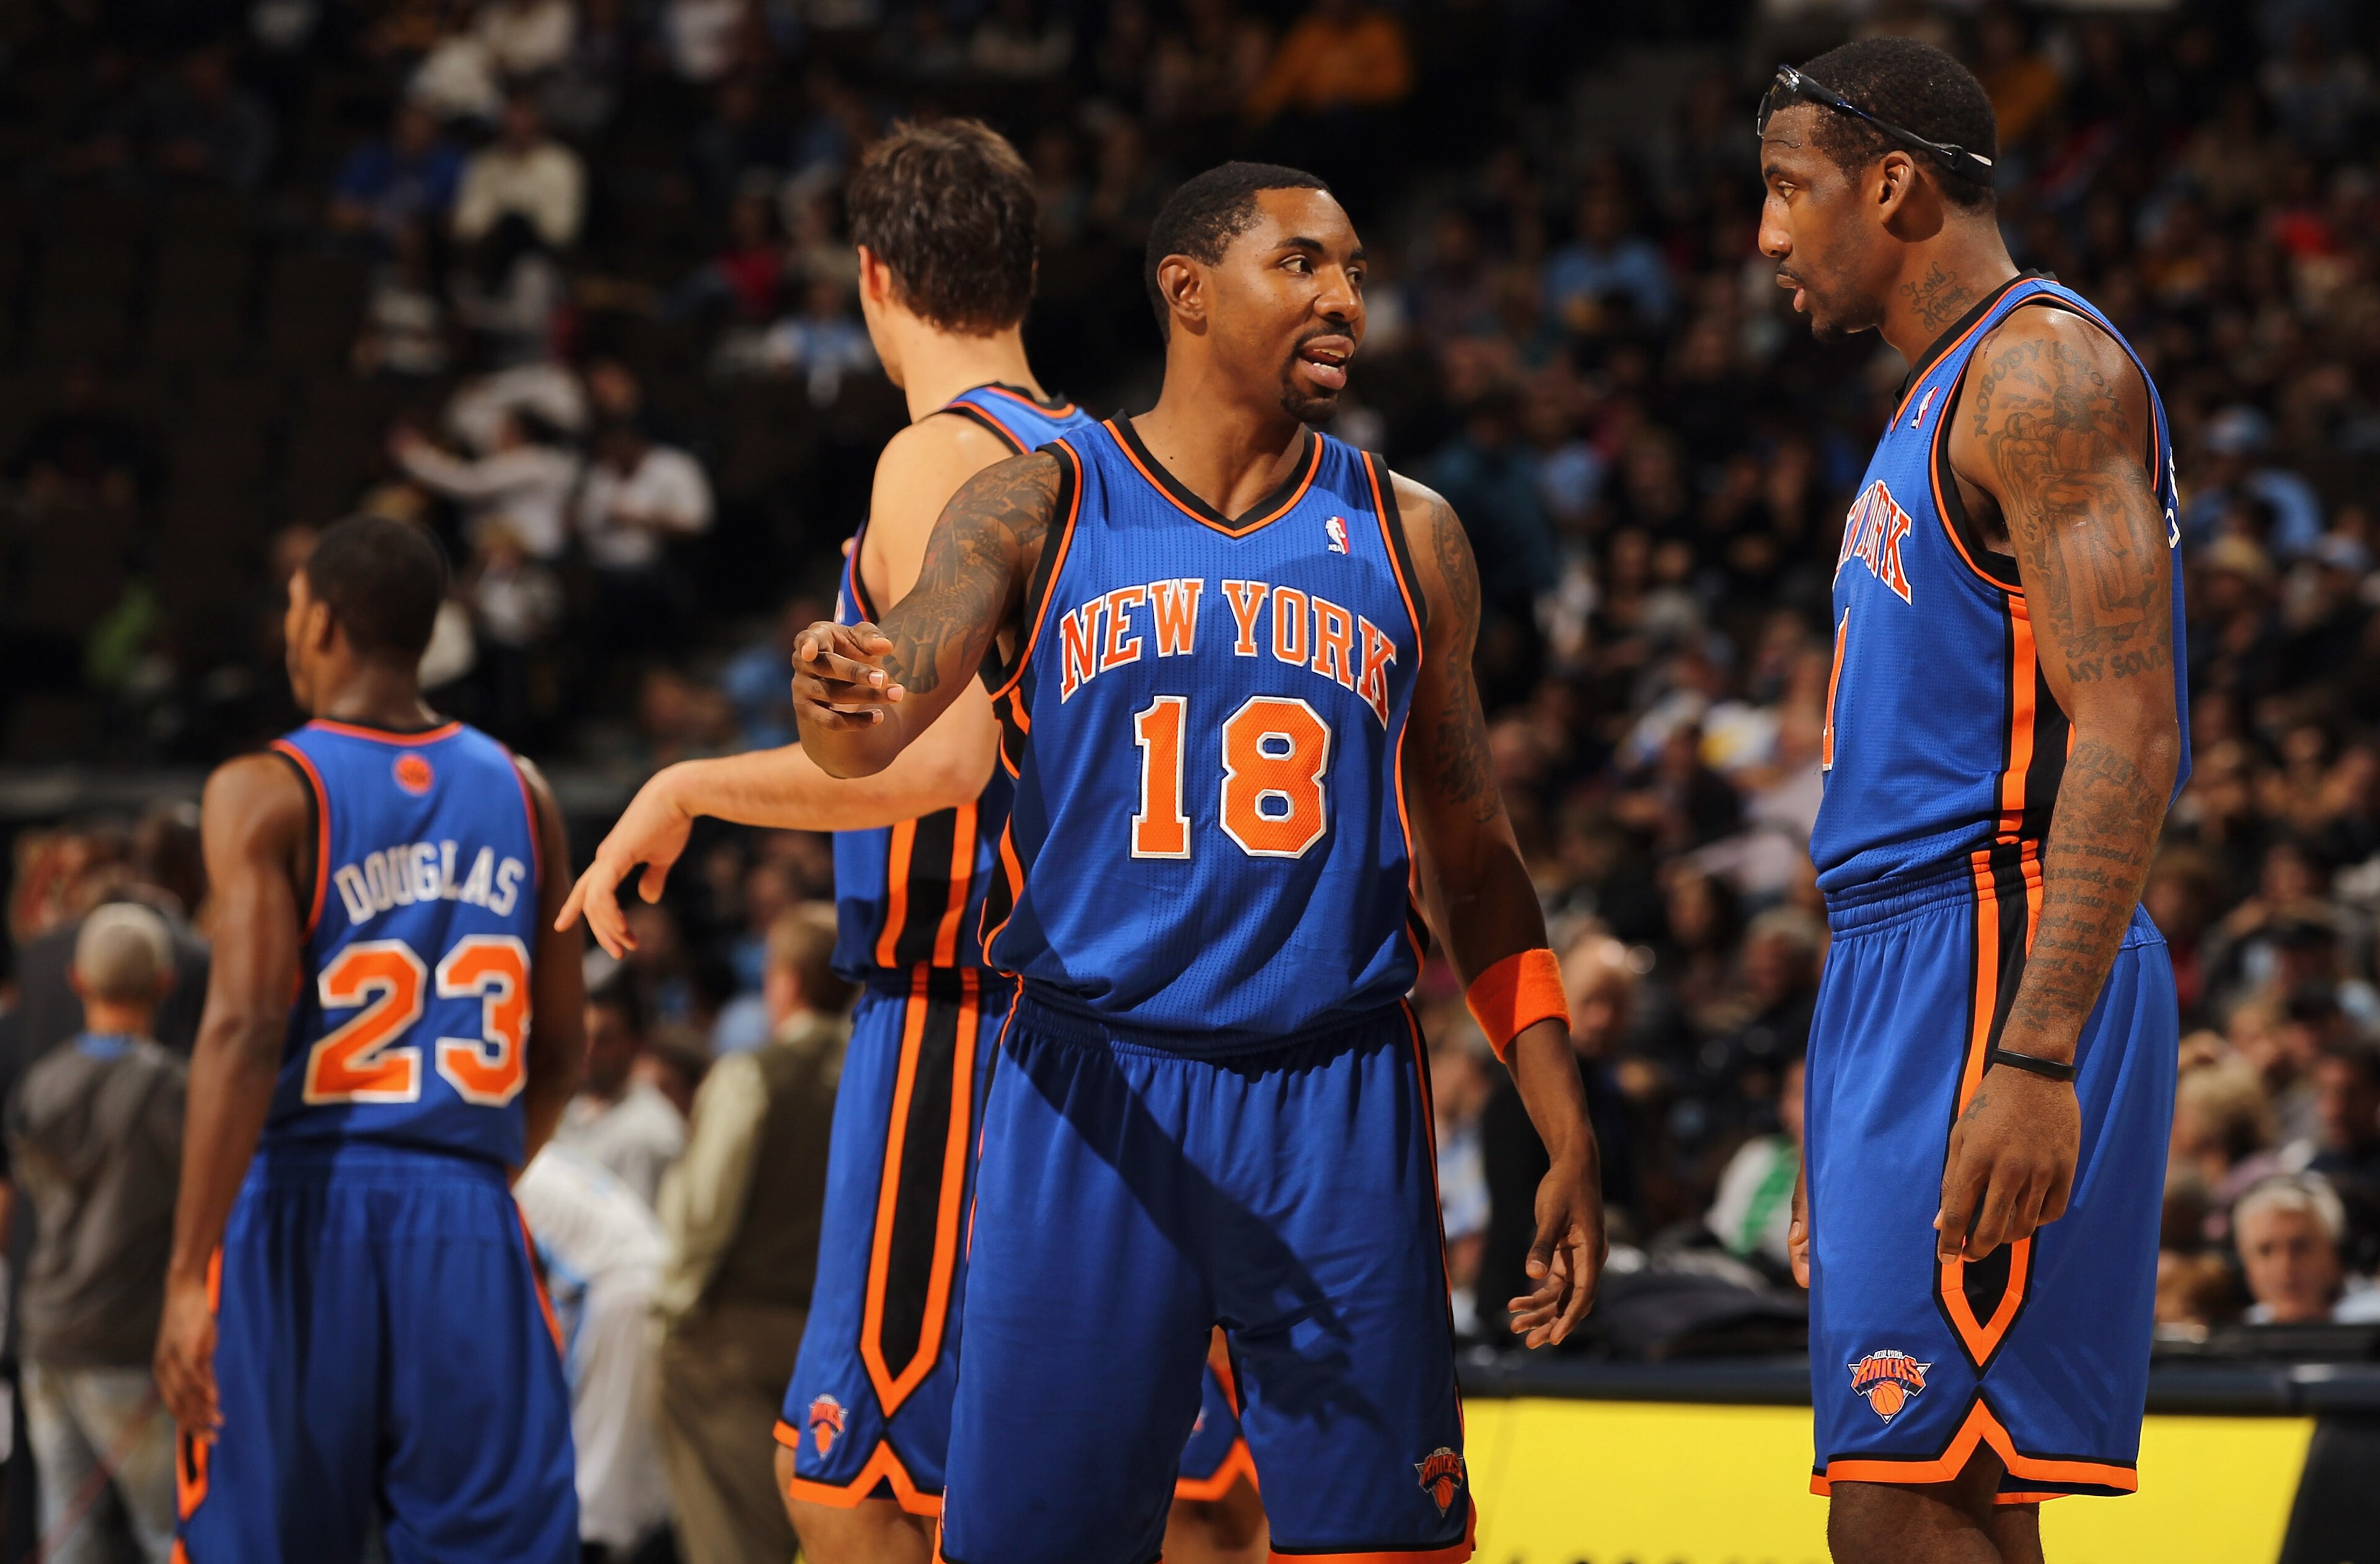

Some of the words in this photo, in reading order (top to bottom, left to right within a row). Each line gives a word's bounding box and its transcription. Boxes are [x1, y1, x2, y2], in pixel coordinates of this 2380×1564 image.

[1973, 338, 2044, 438] NOBODY
[1059, 578, 1204, 704] NEW
[1221, 579, 1397, 731] YORK
[1131, 695, 1332, 860] 18
[333, 839, 526, 926] DOUGLAS
[302, 933, 532, 1109] 23
[1852, 1358, 1924, 1389] KNICKS
